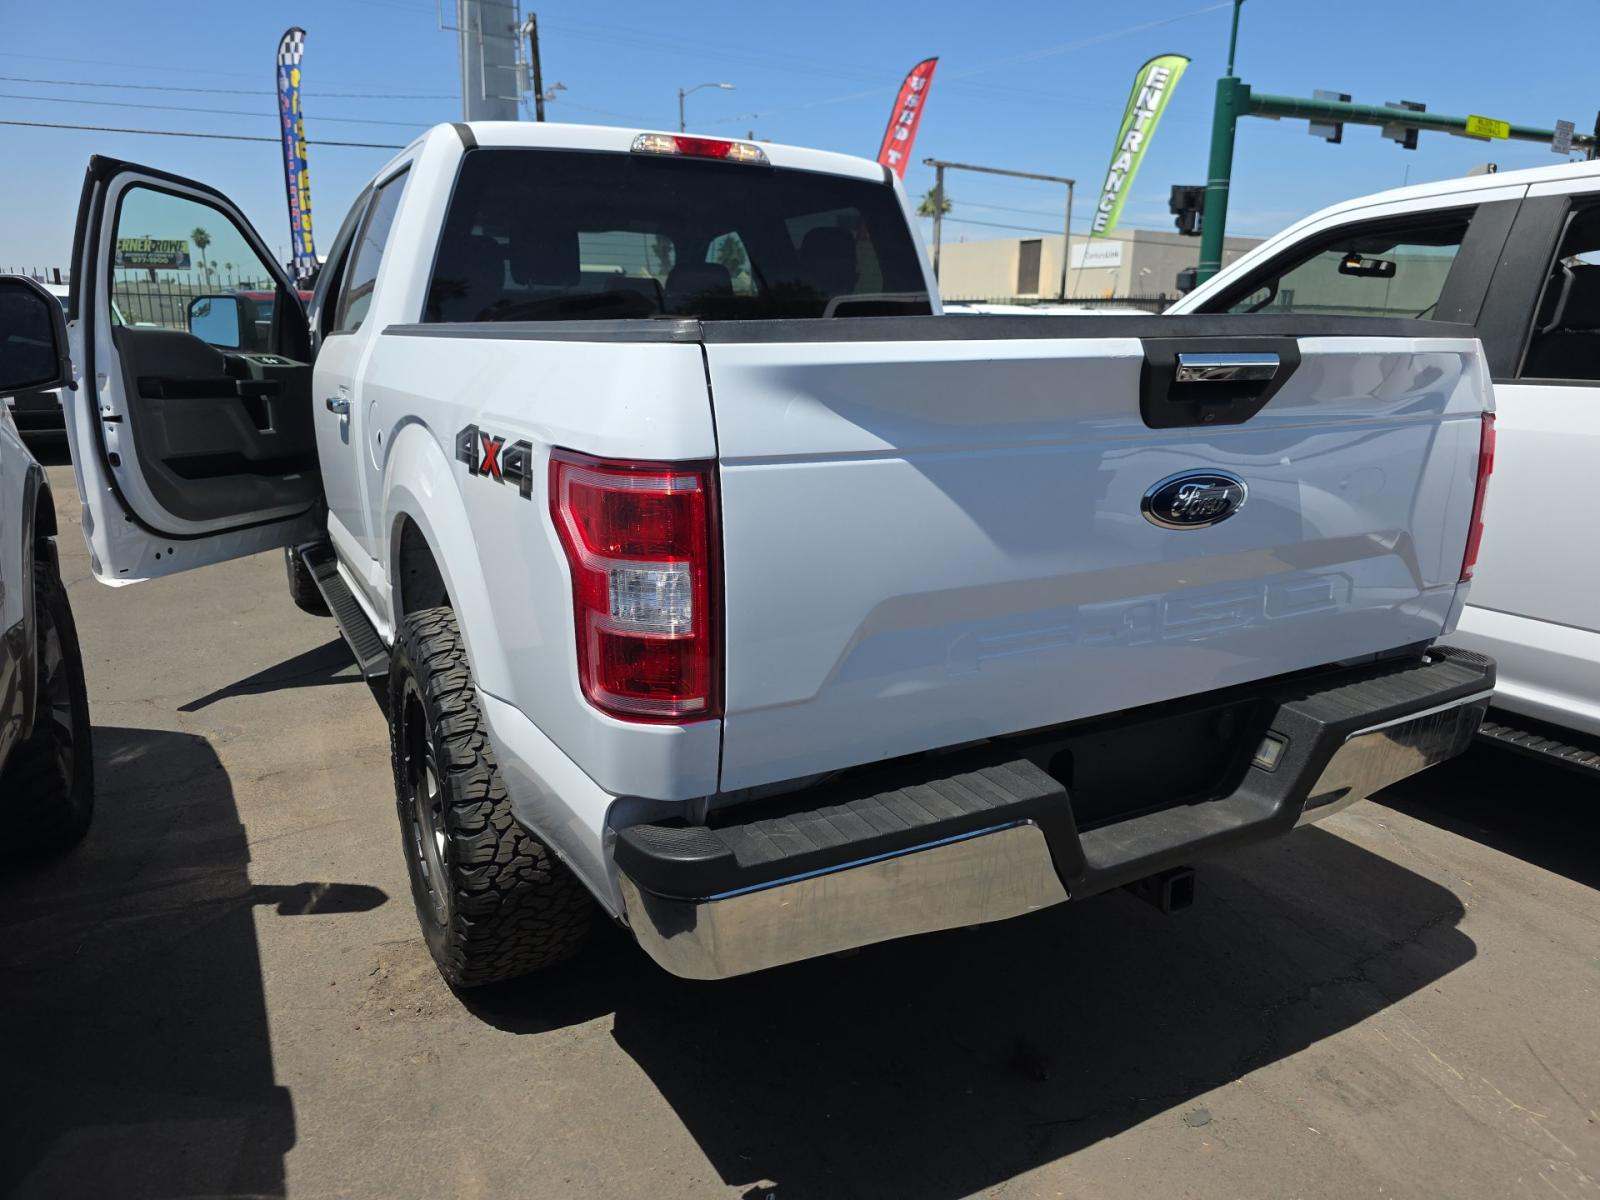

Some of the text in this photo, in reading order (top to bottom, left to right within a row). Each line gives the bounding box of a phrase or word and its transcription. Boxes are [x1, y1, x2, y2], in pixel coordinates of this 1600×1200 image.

[1093, 66, 1170, 232] ENTRANCE
[117, 239, 151, 252] ERNER
[1171, 482, 1231, 518] Ford
